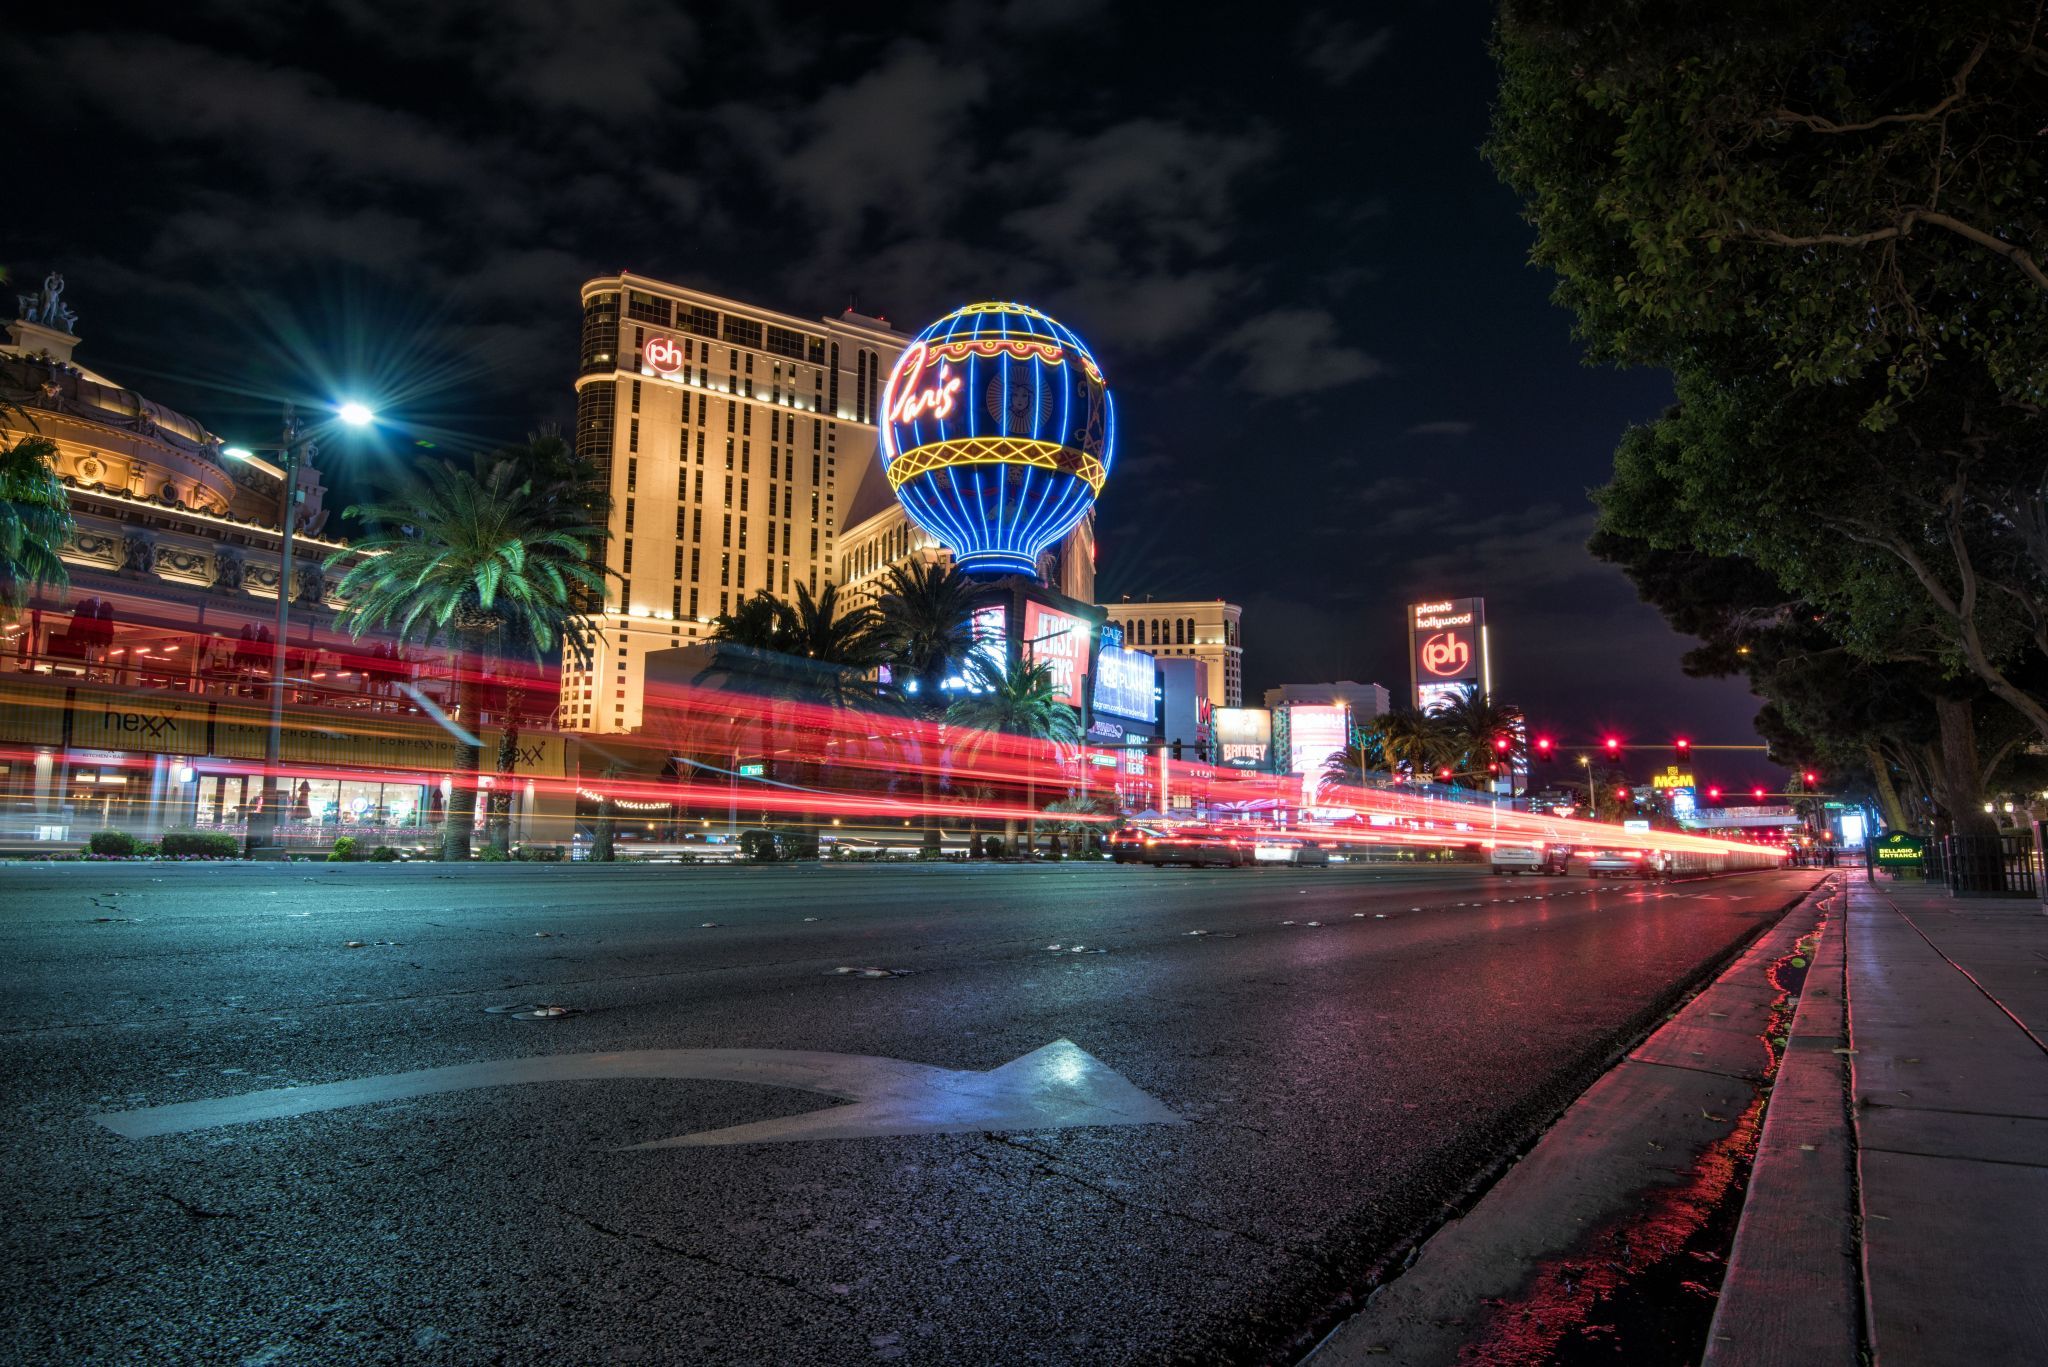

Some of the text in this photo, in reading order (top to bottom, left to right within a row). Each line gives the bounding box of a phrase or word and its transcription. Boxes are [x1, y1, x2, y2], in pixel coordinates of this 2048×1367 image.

[650, 340, 683, 366] ph
[882, 341, 962, 457] Paris
[1416, 602, 1453, 617] planet
[1417, 613, 1472, 629] hollywood
[1427, 633, 1469, 670] ph
[1042, 656, 1074, 699] OYS
[228, 724, 265, 734] CRAF
[280, 728, 360, 744] CHOCOLATE
[1223, 743, 1267, 762] BRITNEY
[1240, 769, 1257, 778] KOI
[1653, 775, 1695, 788] MGM
